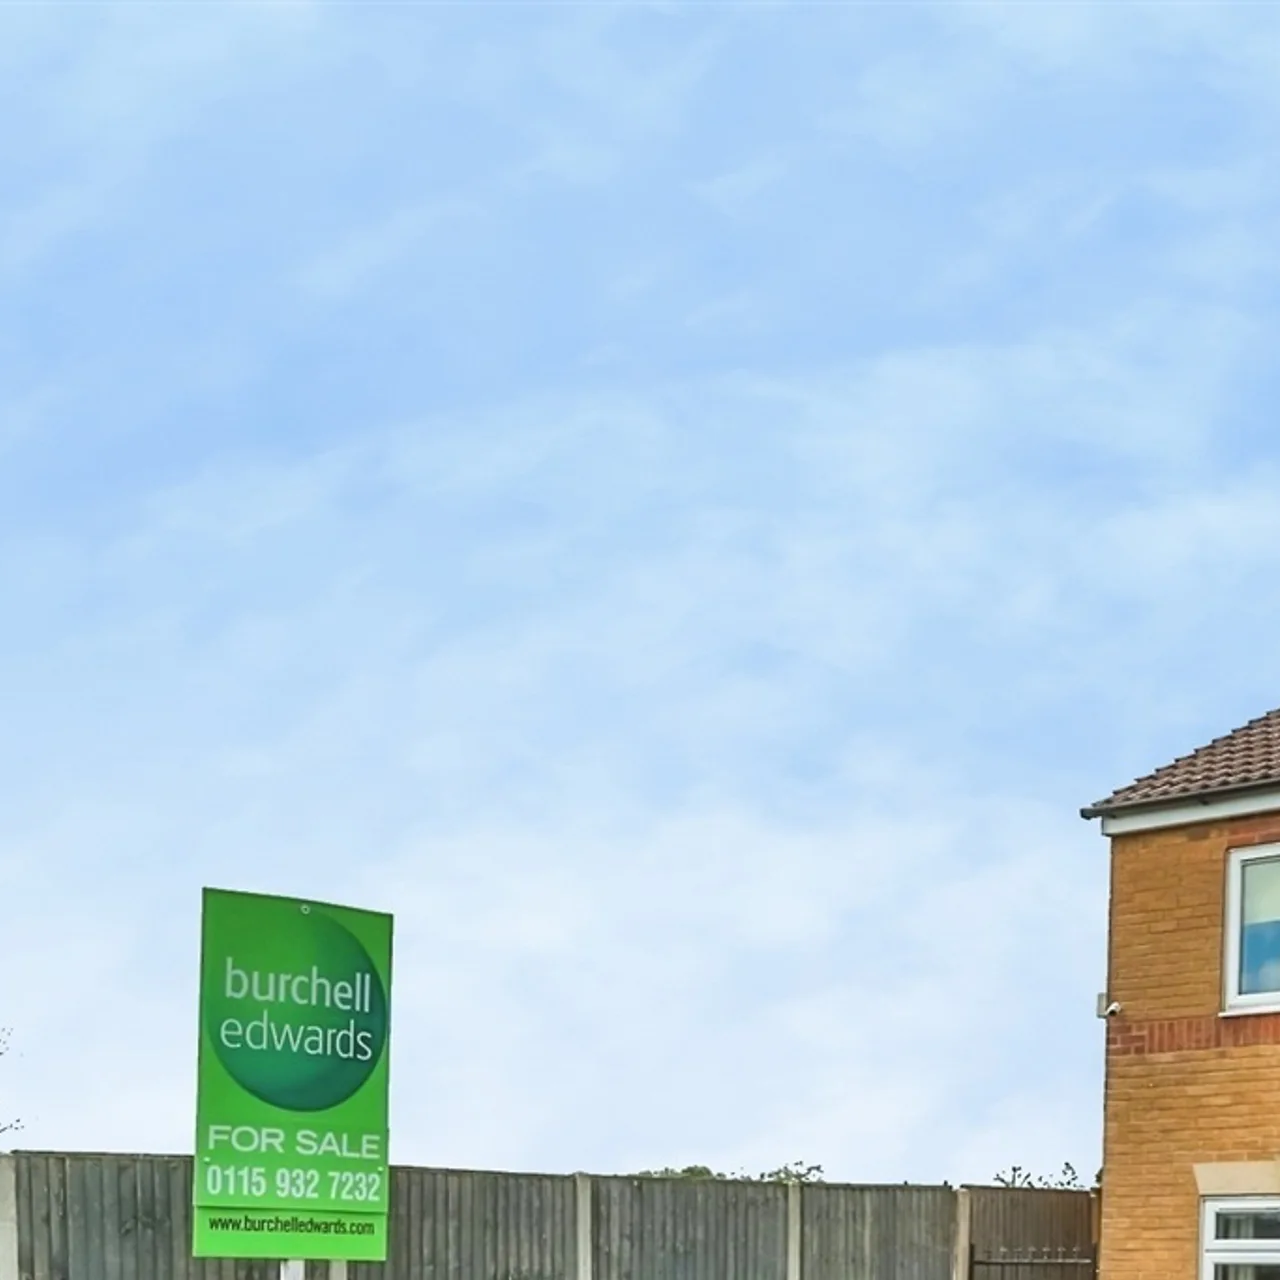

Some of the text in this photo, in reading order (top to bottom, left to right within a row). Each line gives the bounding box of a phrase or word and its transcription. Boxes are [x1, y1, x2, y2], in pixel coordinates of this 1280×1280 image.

[225, 956, 371, 1013] burchell
[220, 1009, 373, 1061] edwards
[208, 1124, 381, 1160] FOR SALE
[206, 1164, 381, 1202] 0115 932 7232
[208, 1214, 376, 1236] www.burchelledwards.com
